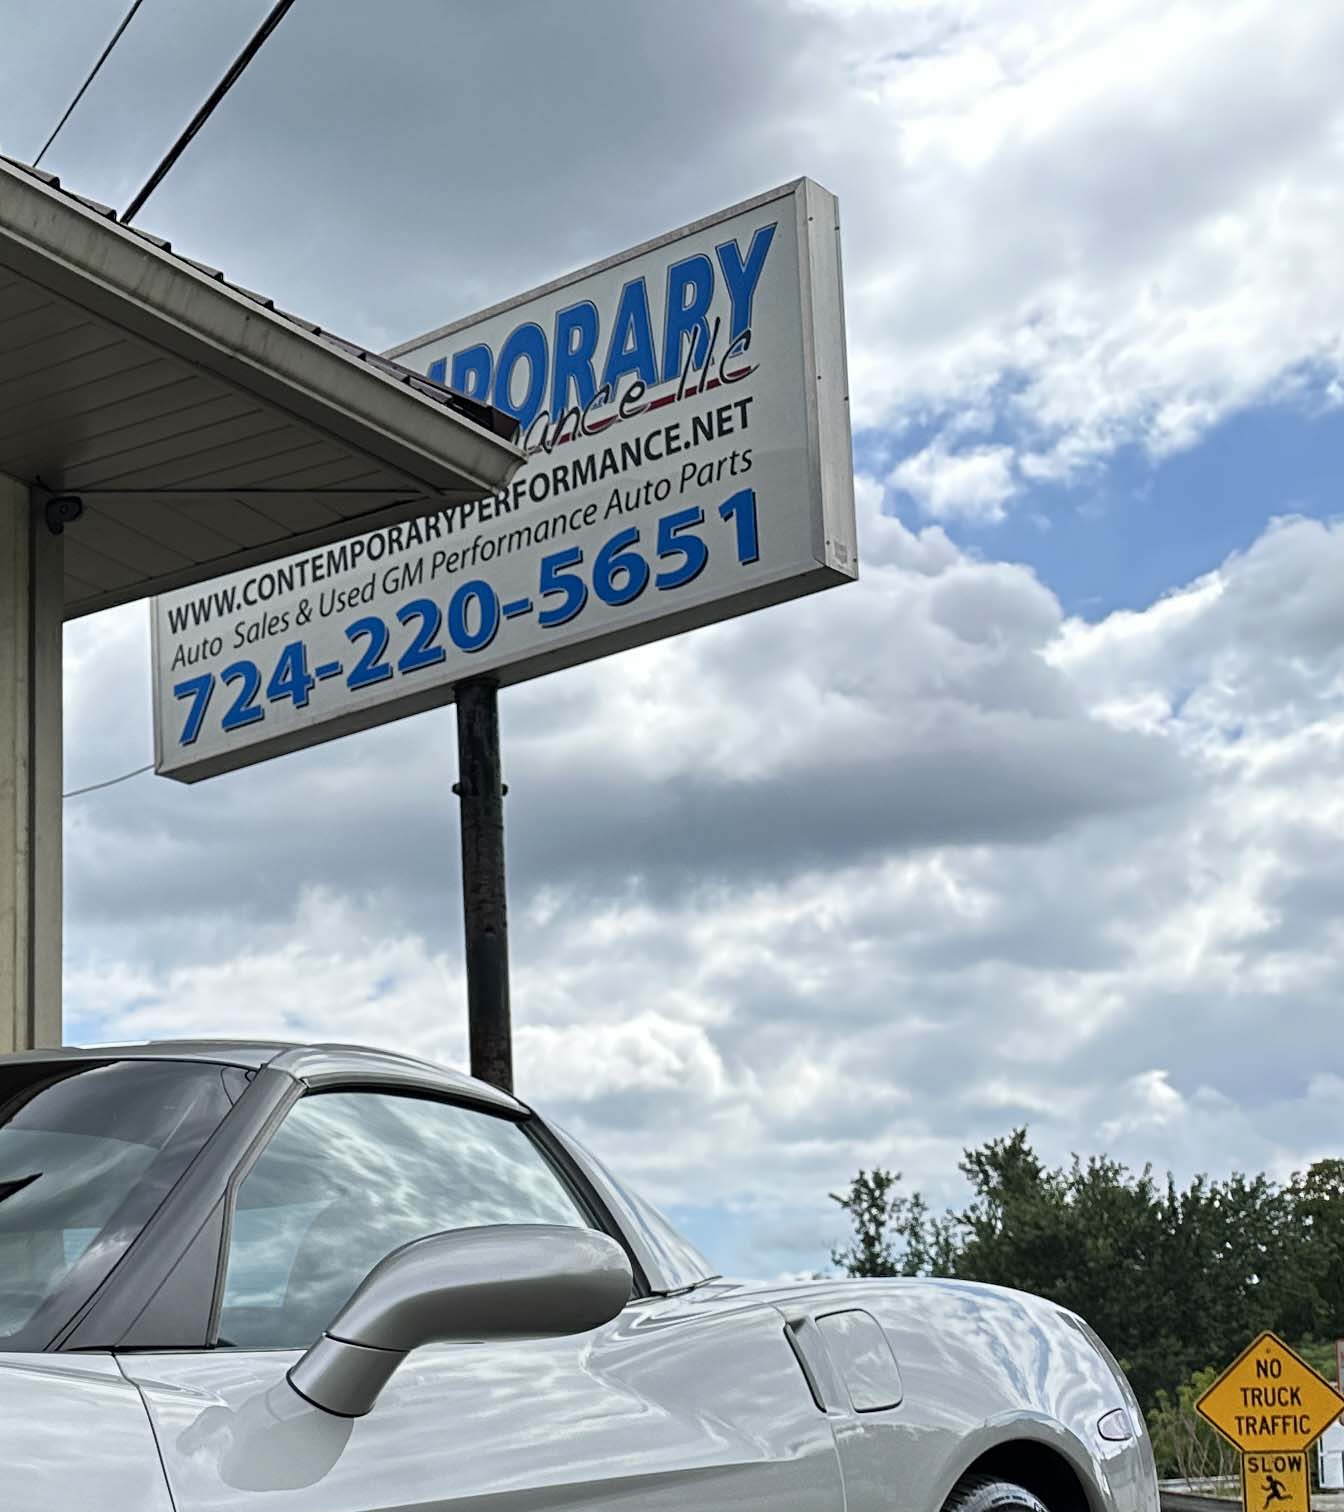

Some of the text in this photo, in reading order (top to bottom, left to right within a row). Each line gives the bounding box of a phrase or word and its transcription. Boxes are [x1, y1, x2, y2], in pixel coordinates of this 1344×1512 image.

[427, 222, 779, 433] PORARY
[513, 380, 649, 455] ance
[168, 397, 753, 635] WWW.CONTEMPORARYPERFORMANCE.NET
[171, 449, 753, 671] Auto Sales & Used GM Performance Auto Parts
[173, 487, 761, 747] 724-220-5651
[1240, 1386, 1302, 1408] TRUCK
[1256, 1358, 1282, 1380] NO
[1234, 1414, 1312, 1436] TRAFFIC
[1247, 1455, 1303, 1474] SLOW
